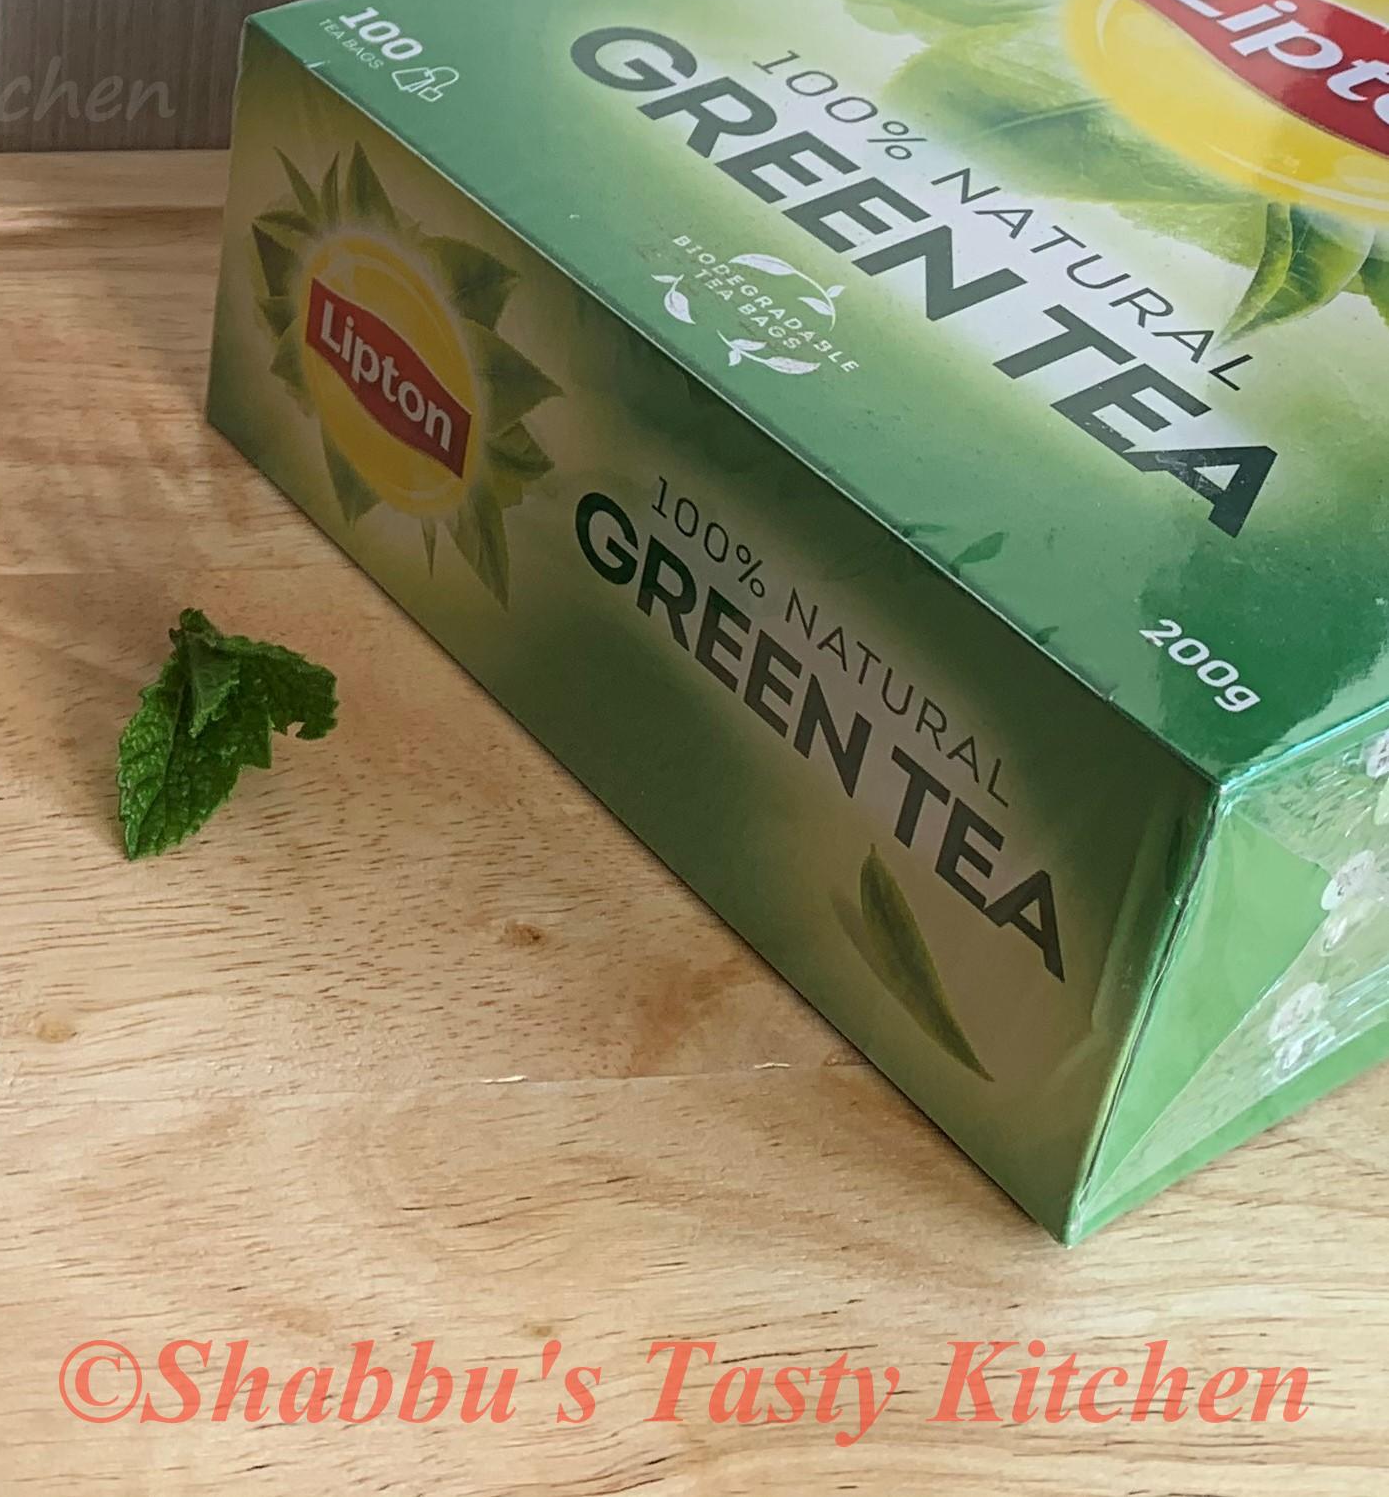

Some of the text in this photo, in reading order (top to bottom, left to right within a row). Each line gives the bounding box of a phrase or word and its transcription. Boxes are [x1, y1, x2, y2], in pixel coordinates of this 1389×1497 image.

[319, 18, 384, 69] TEA BAGS
[339, 7, 423, 60] 100
[570, 27, 1278, 539] GREEN TEA
[753, 49, 1255, 392] 100% NATURAL
[672, 235, 860, 372] BIODEGRADABLE
[695, 269, 801, 349] TEA BAGS
[320, 300, 453, 452] Lipton
[651, 475, 1009, 808] 100% NATURAL
[1139, 619, 1261, 712] 200g
[575, 492, 1065, 983] GREEN TEA
